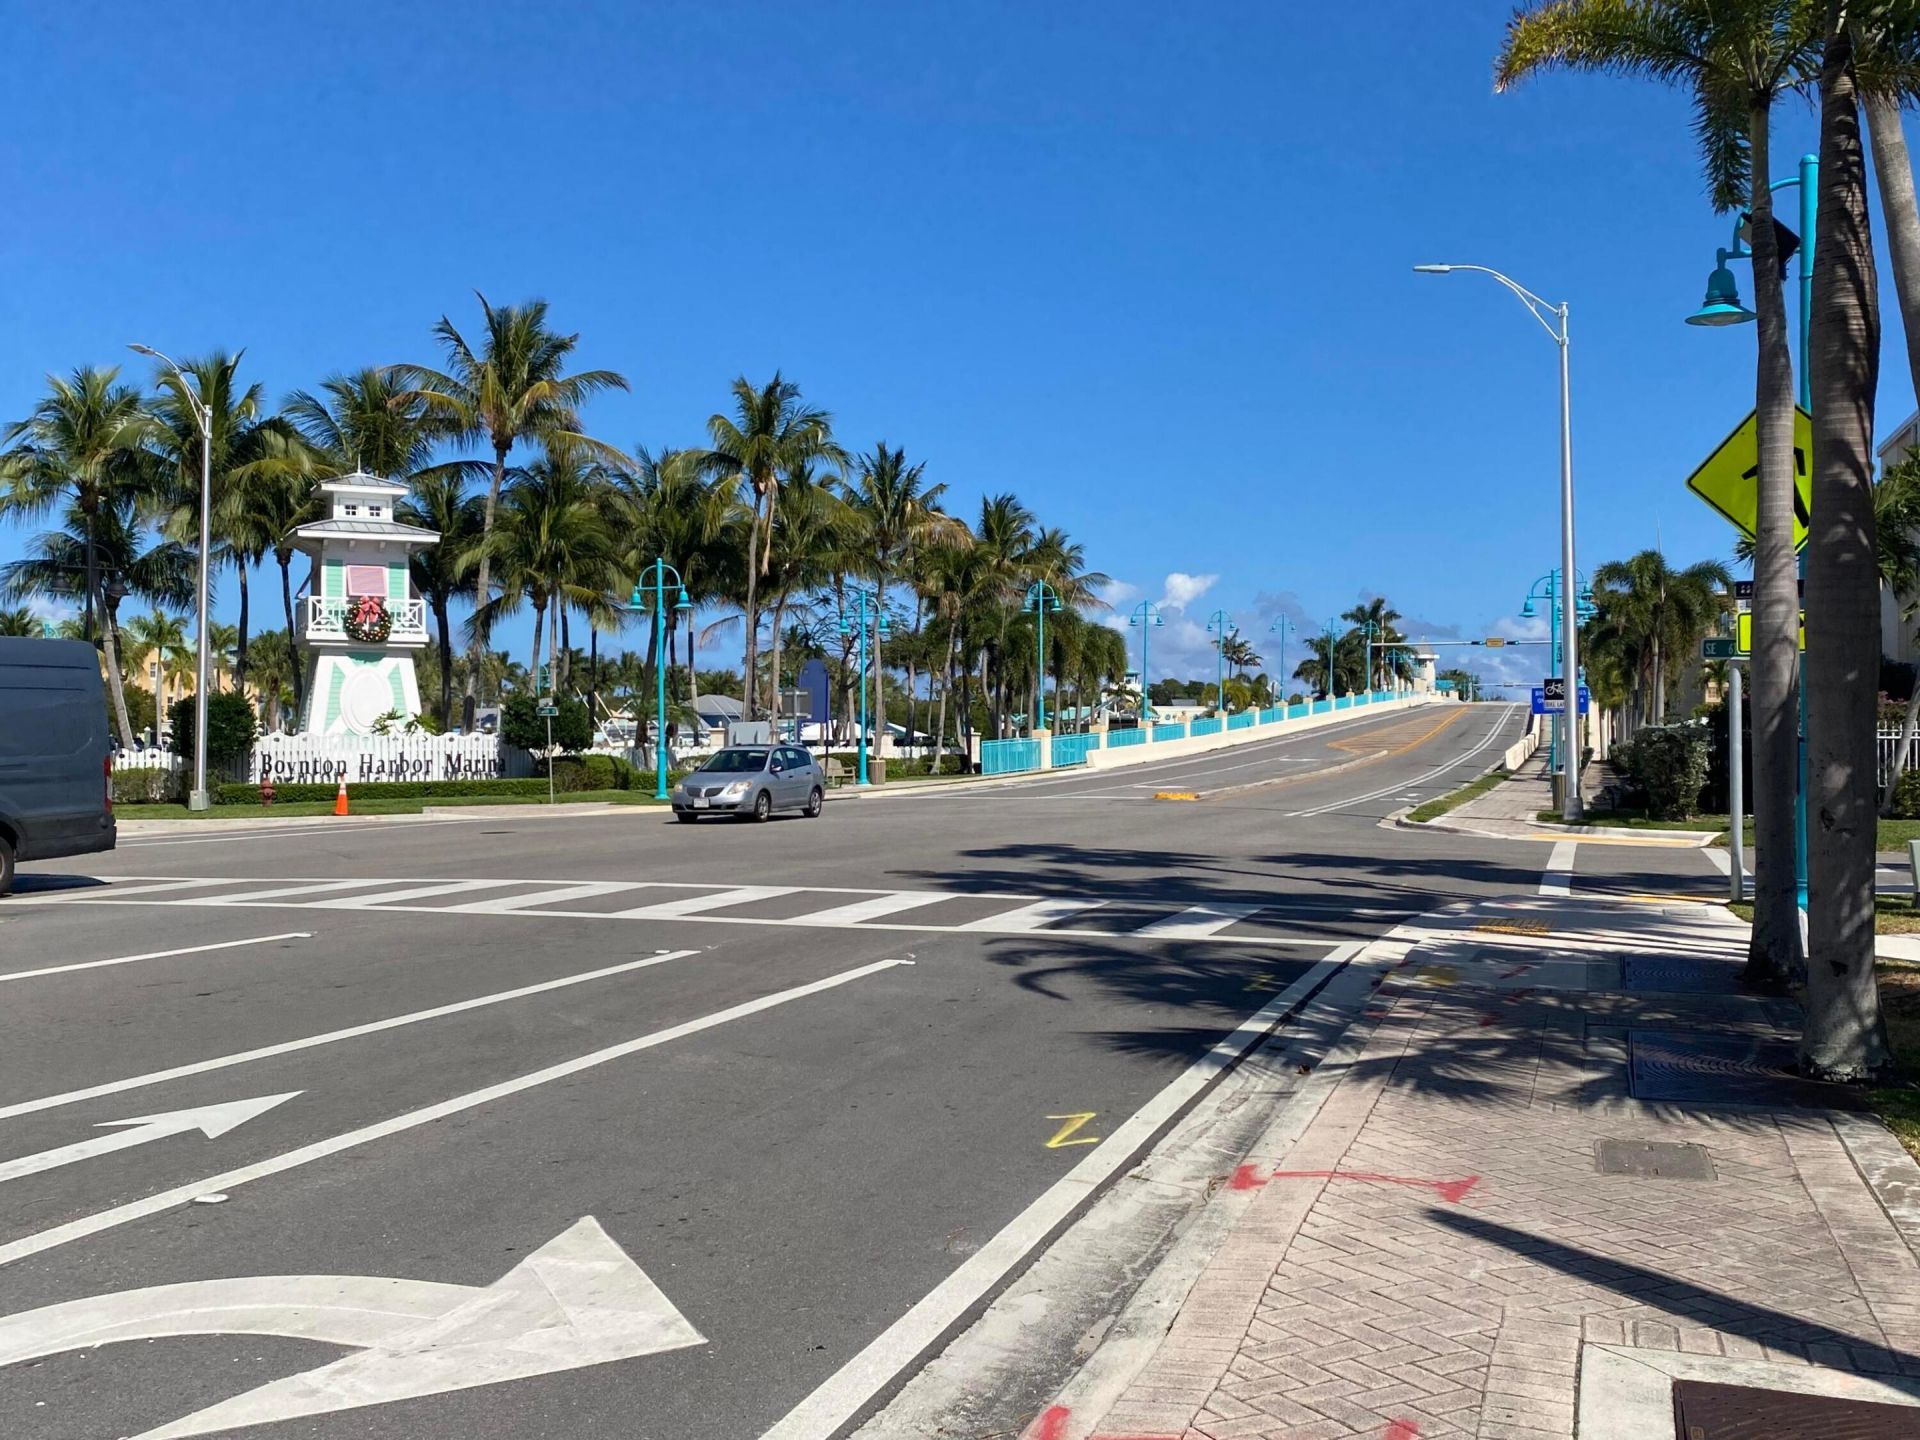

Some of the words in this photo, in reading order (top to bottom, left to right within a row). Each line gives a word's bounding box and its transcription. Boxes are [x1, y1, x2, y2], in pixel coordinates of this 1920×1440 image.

[1705, 642, 1717, 655] SE
[261, 753, 348, 777] Boynton
[359, 751, 433, 774] Harbor
[445, 753, 506, 773] Marina
